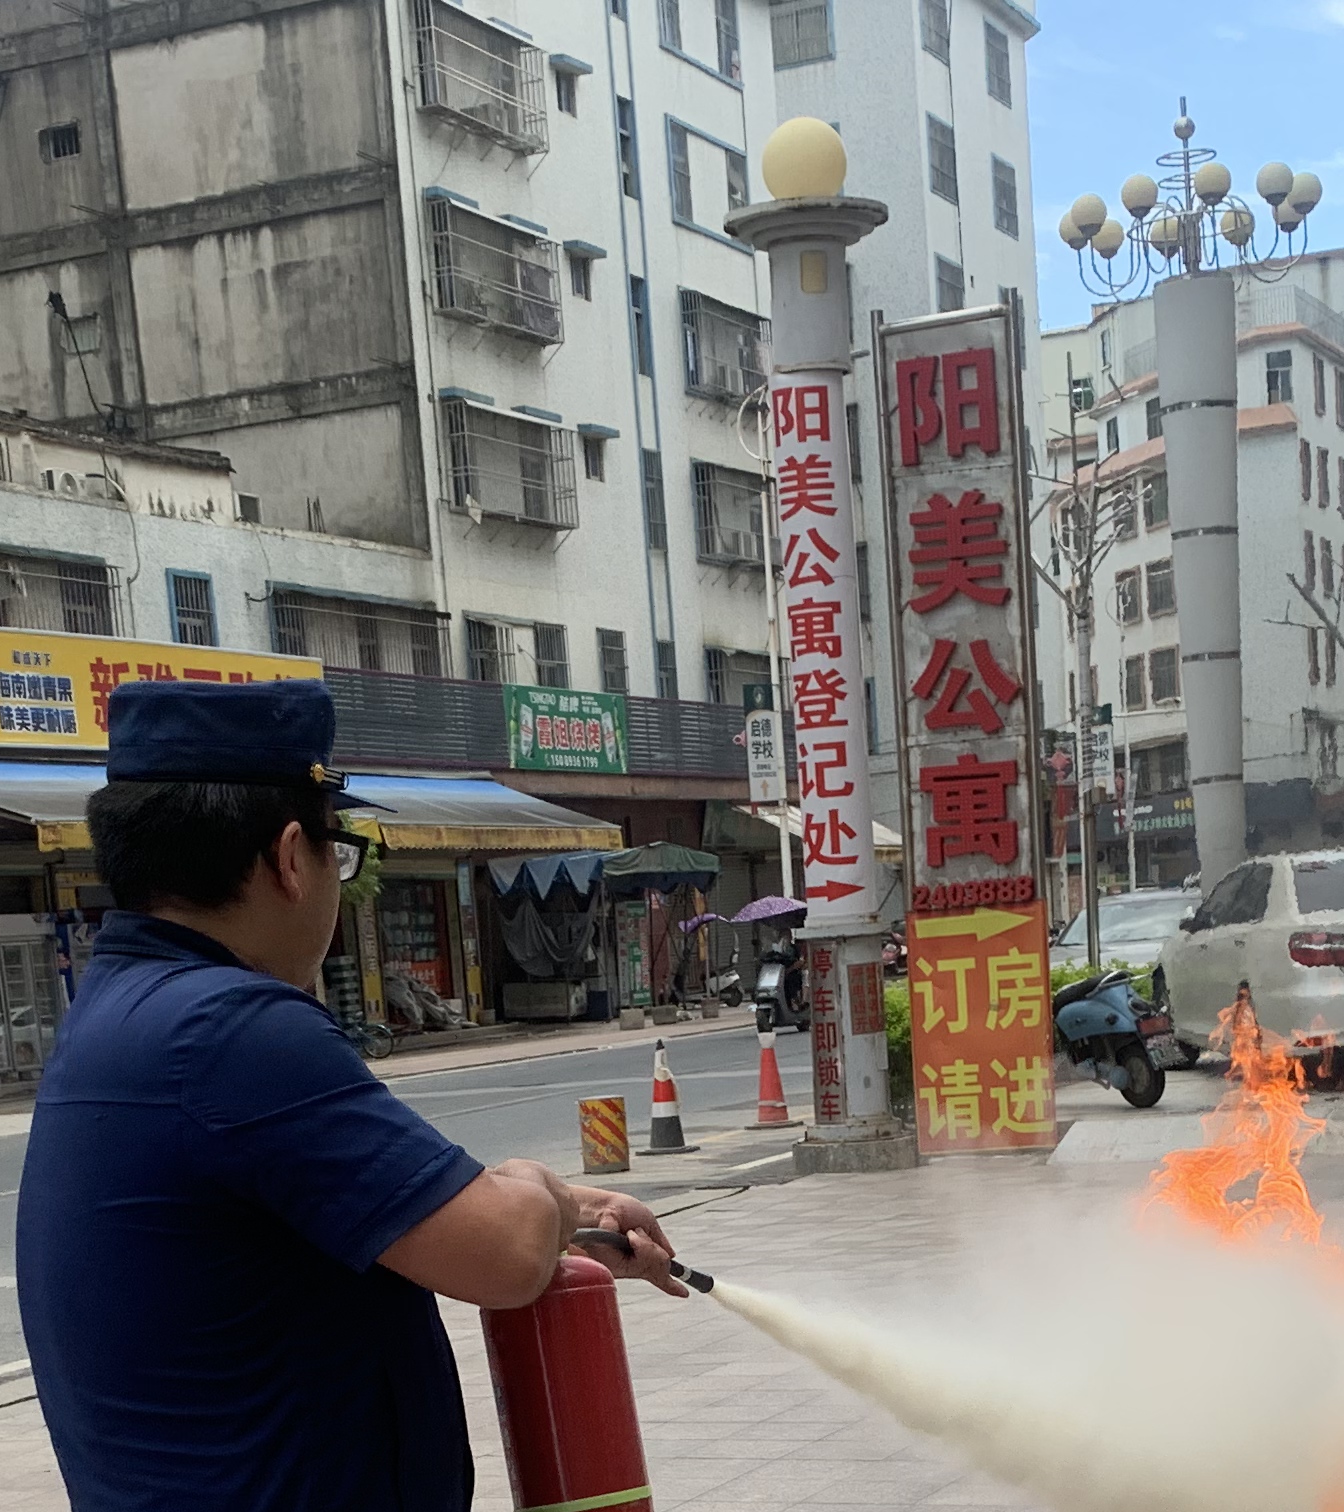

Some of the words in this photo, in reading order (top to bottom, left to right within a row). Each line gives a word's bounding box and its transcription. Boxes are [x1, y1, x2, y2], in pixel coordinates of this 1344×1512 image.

[771, 385, 860, 868] 阳美公寓登记处
[895, 347, 1021, 868] 阳美公寓
[751, 719, 772, 738] 启德
[752, 740, 774, 760] 学校
[912, 876, 1033, 911] 2403888
[913, 947, 1044, 1034] 订房
[811, 947, 842, 1121] 停车即锁车
[919, 1056, 1054, 1140] 请进
